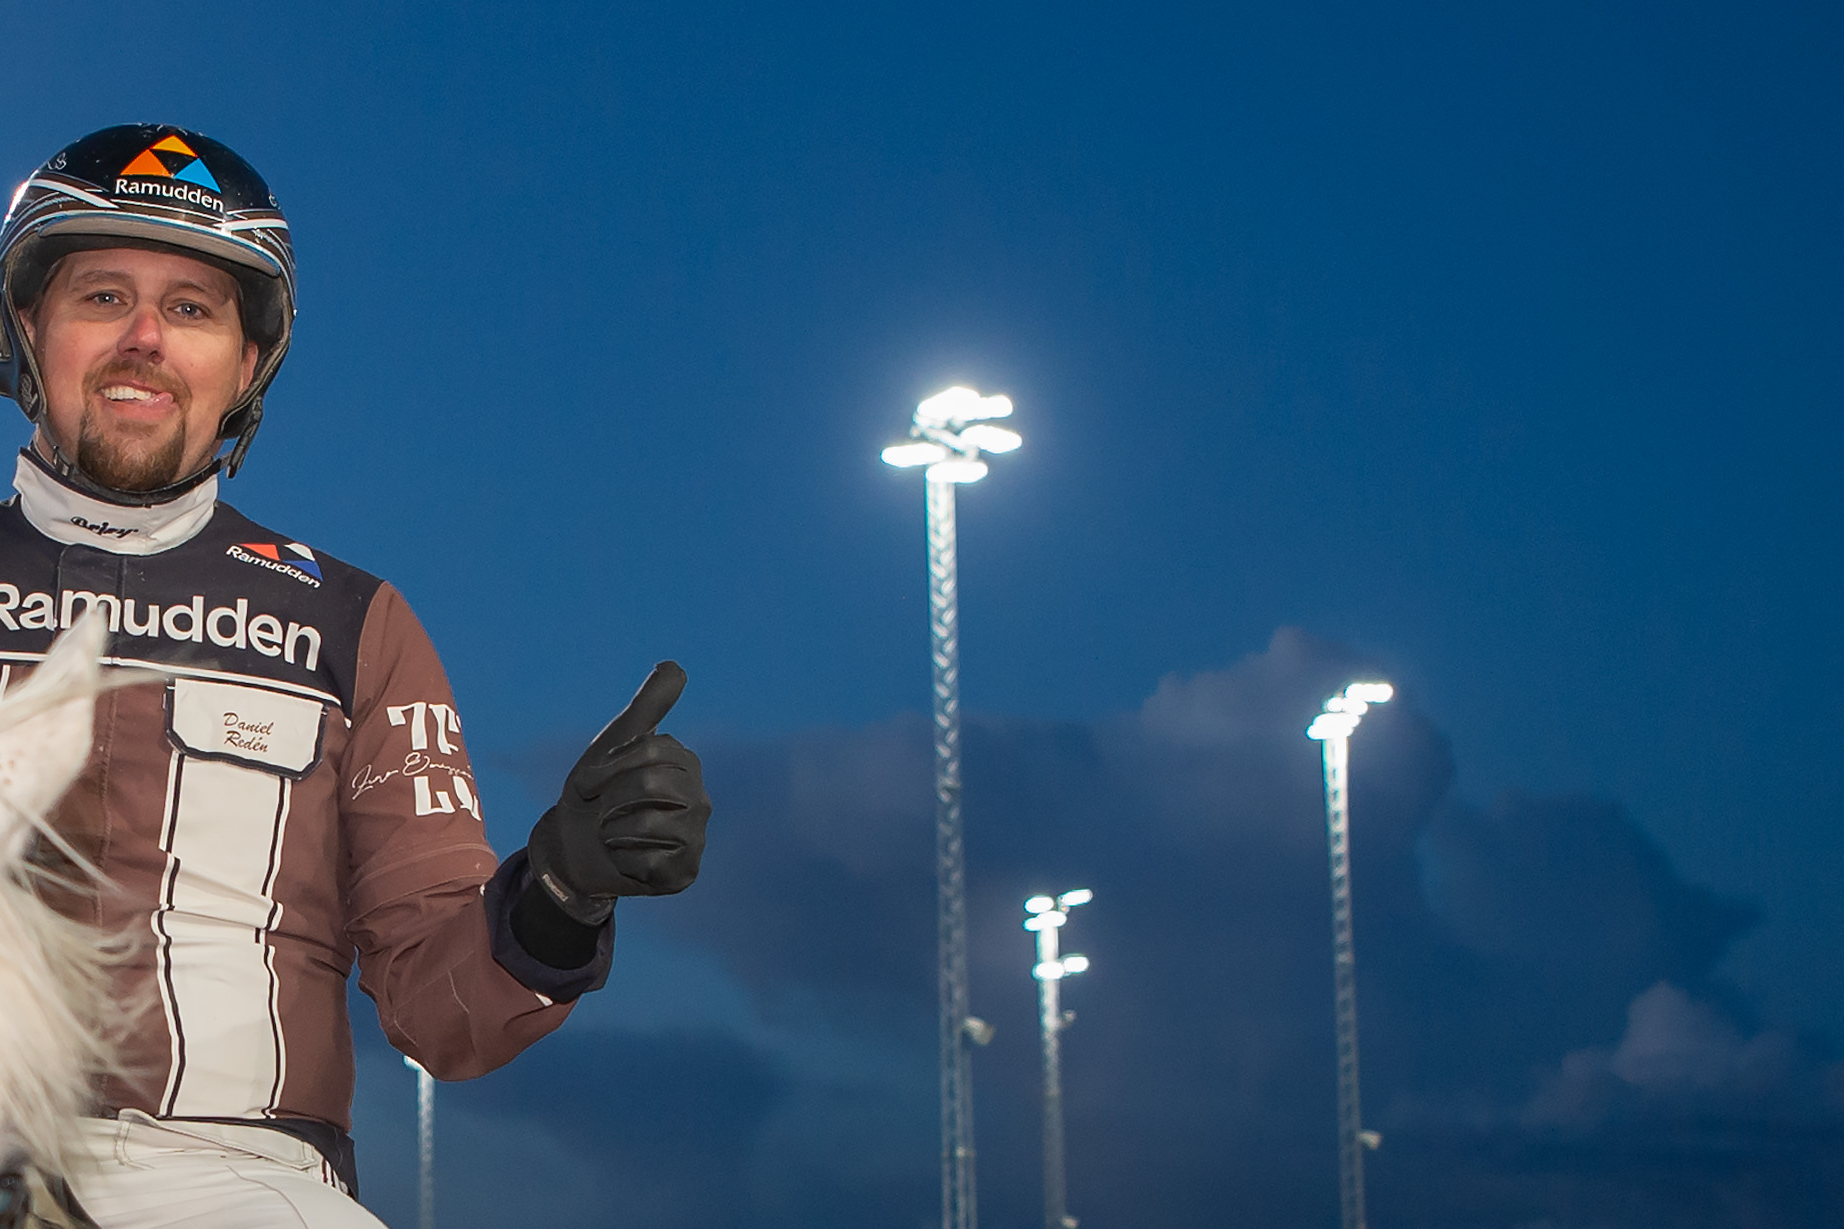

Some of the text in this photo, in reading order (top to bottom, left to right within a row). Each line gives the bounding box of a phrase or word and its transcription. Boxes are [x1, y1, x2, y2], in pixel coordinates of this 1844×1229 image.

[114, 177, 224, 213] Ramudden
[225, 544, 321, 589] Ramudden
[223, 712, 274, 736] Daniel
[222, 730, 269, 753] Redén
